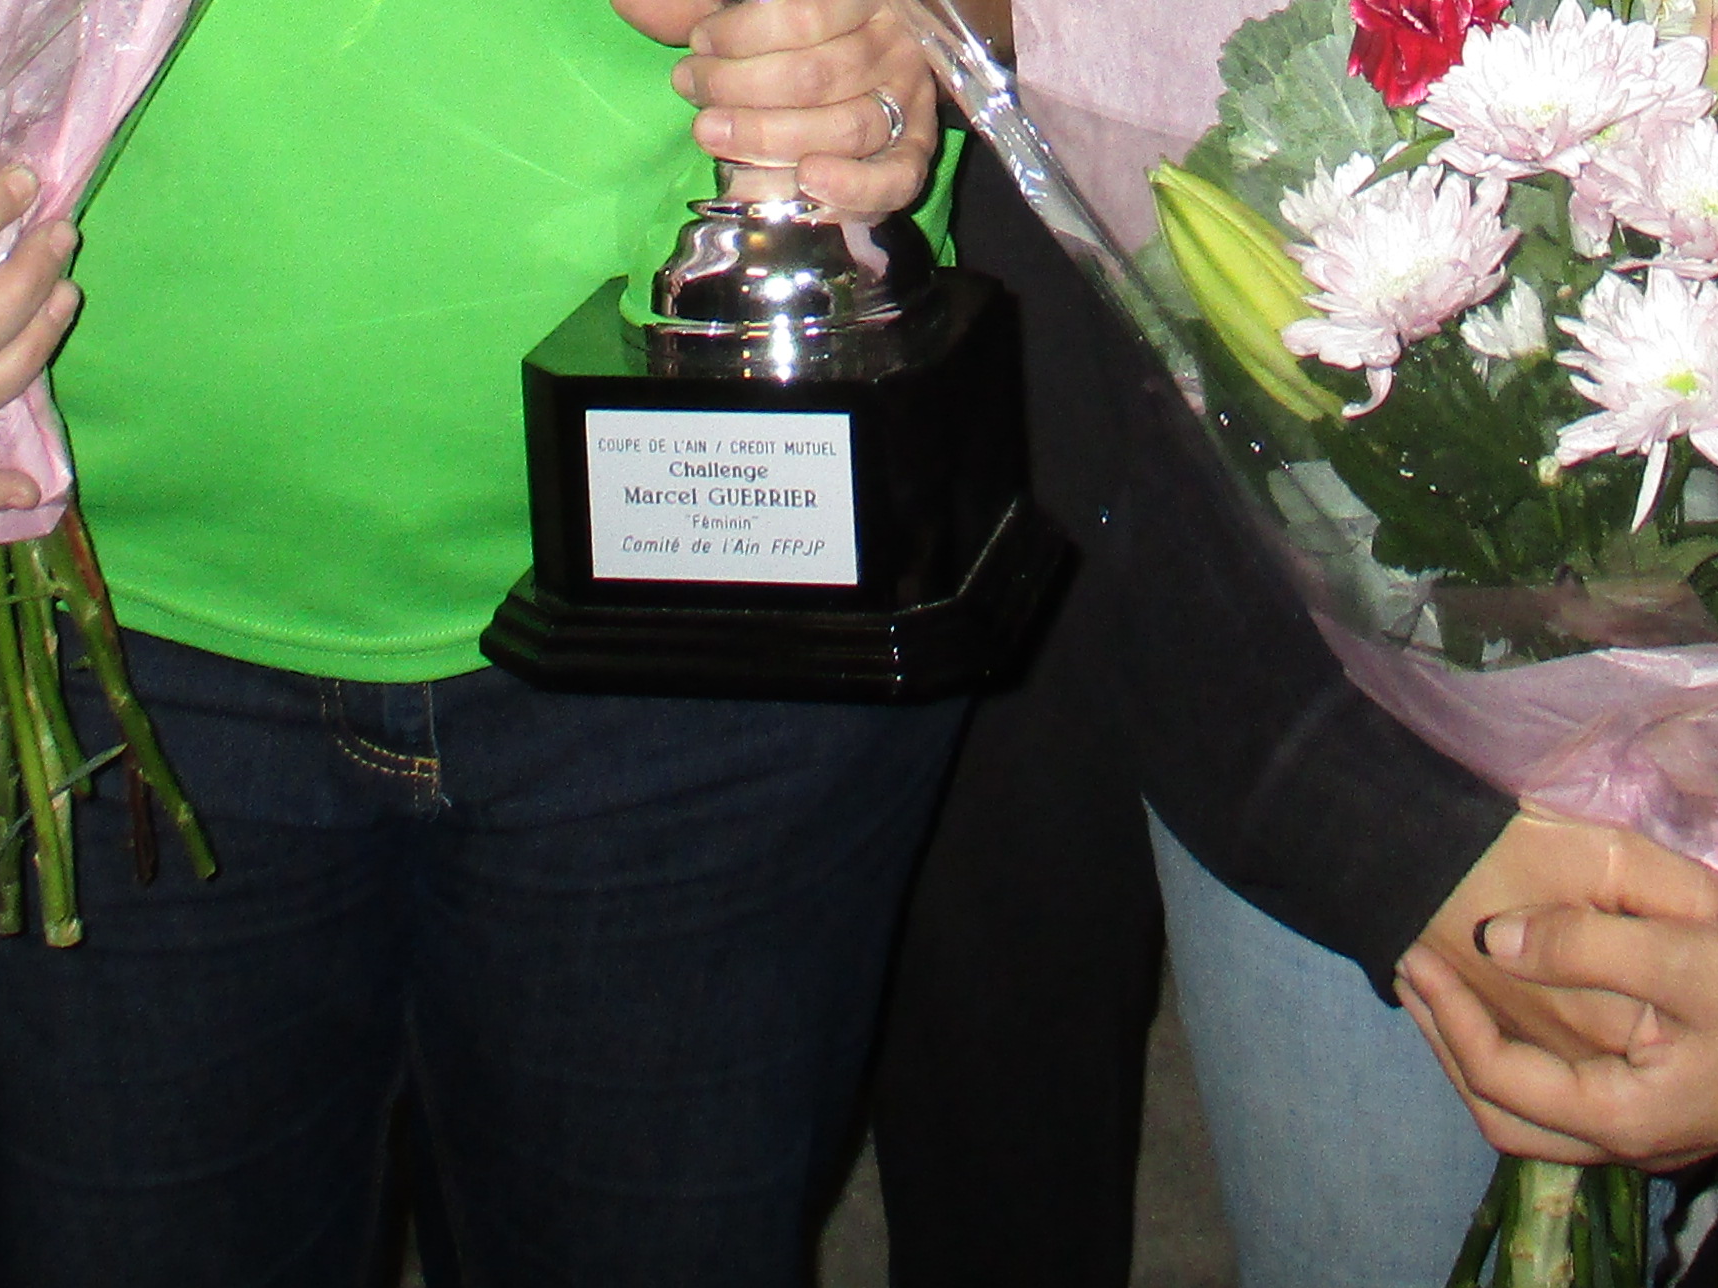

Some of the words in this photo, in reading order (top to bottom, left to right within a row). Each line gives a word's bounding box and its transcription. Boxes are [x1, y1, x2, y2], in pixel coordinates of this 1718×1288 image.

[597, 438, 642, 453] COUPE
[649, 438, 667, 453] DE
[673, 439, 708, 454] L'AIN
[715, 440, 722, 454] /
[730, 440, 777, 455] CREDIT
[784, 441, 837, 456] MUTUEL
[668, 460, 769, 483] Challenge
[624, 487, 698, 505] Marcel
[708, 487, 819, 508] GUERRIER
[622, 534, 680, 554] Comité
[691, 537, 712, 554] de
[722, 538, 760, 555] l'Ain
[771, 538, 826, 557] FFPJP
